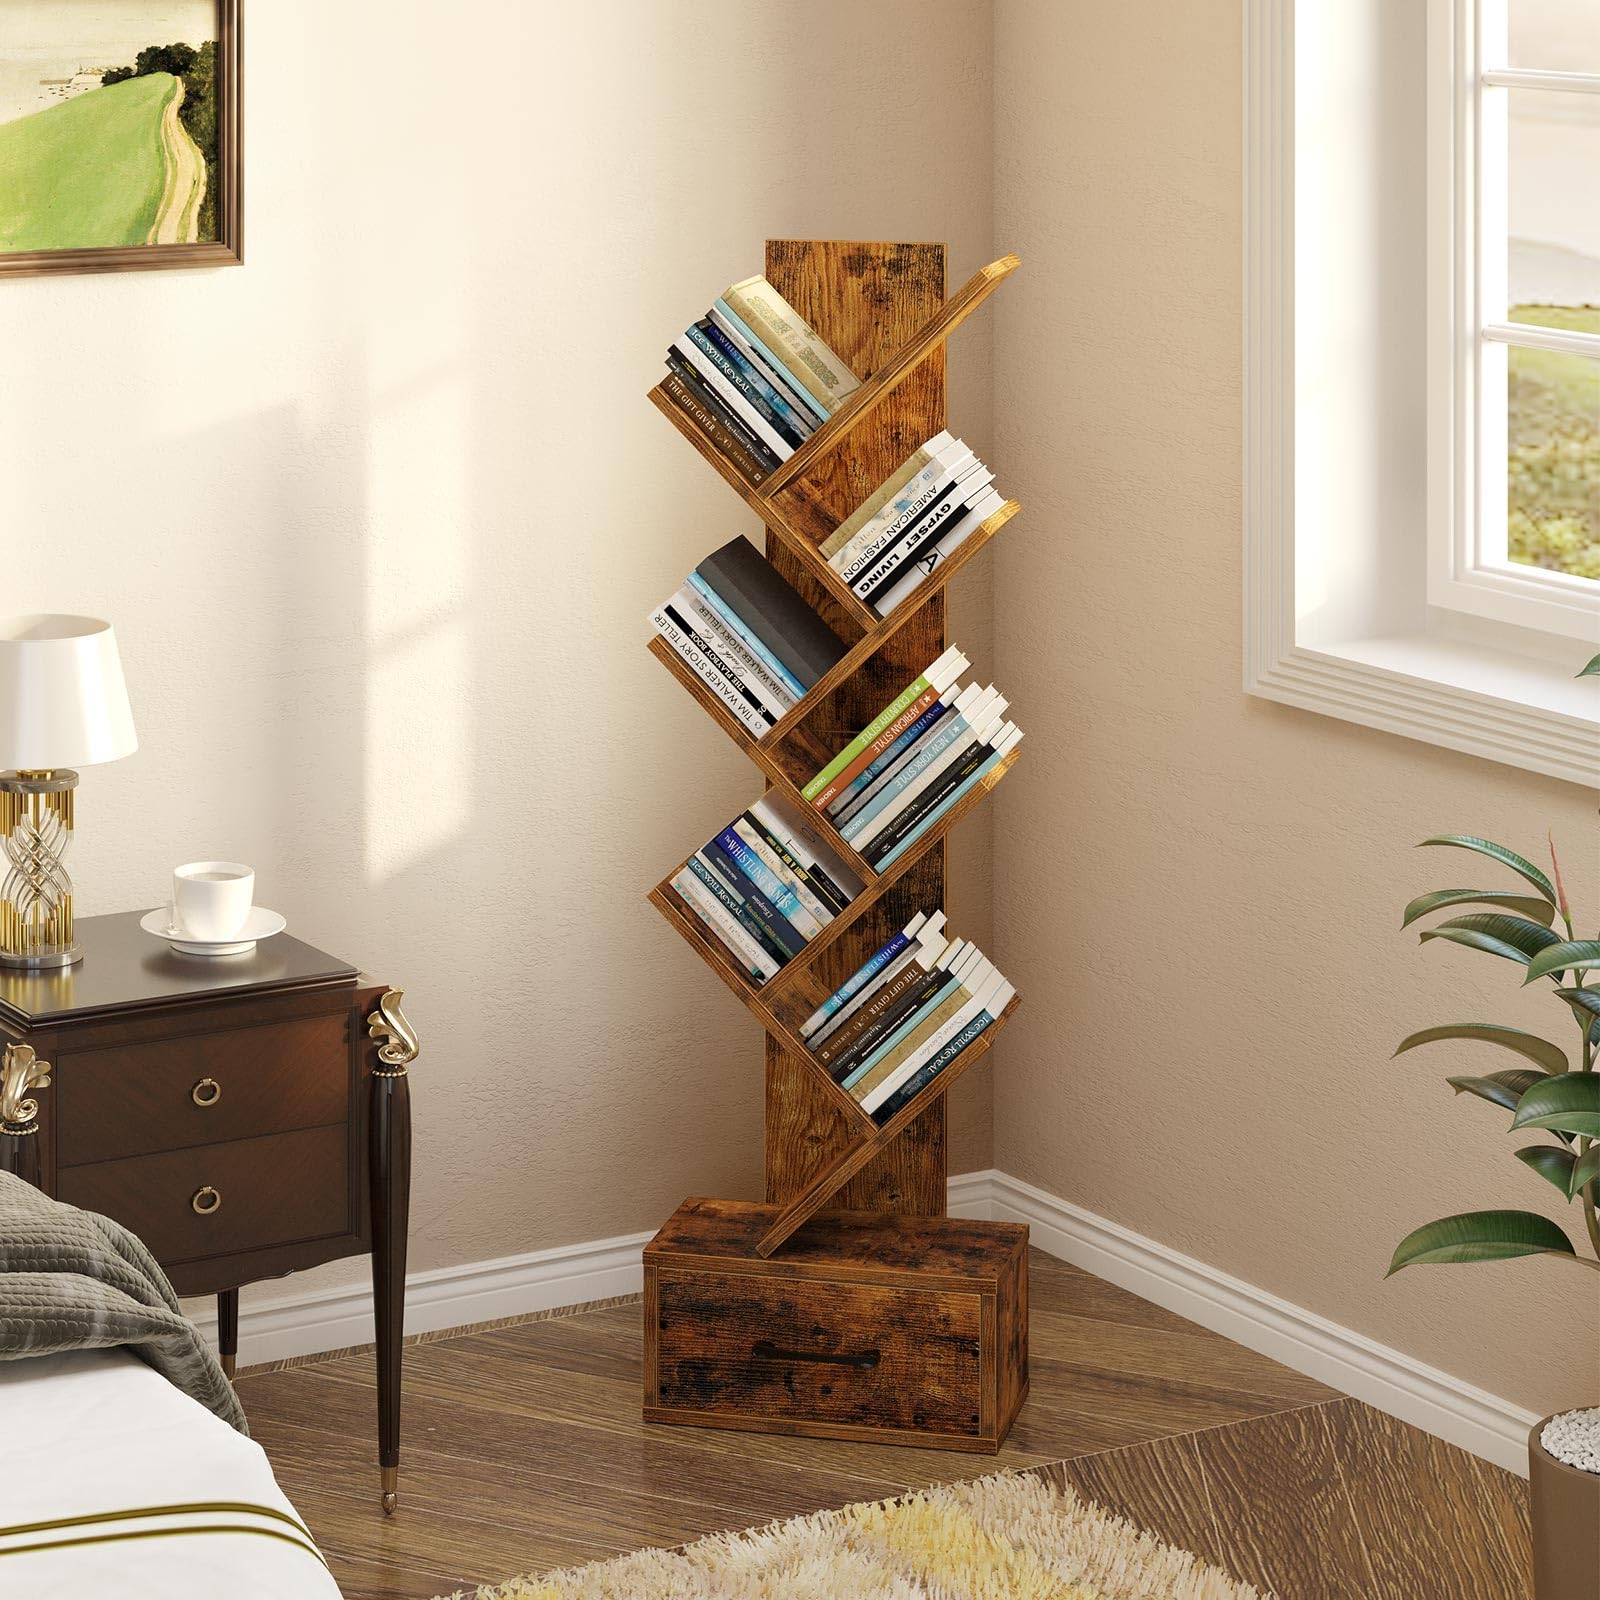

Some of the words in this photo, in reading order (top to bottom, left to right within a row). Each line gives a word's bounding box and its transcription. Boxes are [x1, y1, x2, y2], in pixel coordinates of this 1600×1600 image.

[667, 380, 683, 396] THE
[680, 393, 698, 412] GIFT
[693, 408, 716, 432] GIVER
[885, 484, 939, 537] AMERICAN
[903, 502, 952, 550] GYPSET
[842, 535, 887, 579] FASHION
[858, 552, 900, 593] LIVING
[652, 613, 683, 642] TELLER
[696, 605, 723, 631] TELLER
[687, 630, 708, 651] BOOK
[718, 628, 744, 654] STORY
[678, 641, 709, 671] STORY
[703, 649, 735, 679] PLAYBOY
[740, 652, 771, 683] WALKER
[701, 668, 741, 706] WALKER
[730, 676, 746, 692] THE
[766, 681, 782, 696] TIM
[735, 703, 754, 721] TIM
[877, 694, 910, 727] COUNTRY
[889, 704, 921, 735] AFRICAN
[858, 722, 881, 745] STYLE
[870, 730, 894, 753] STYLE
[929, 735, 949, 754] NEW
[912, 749, 934, 770] YORK
[805, 775, 826, 796] TASCHEN
[893, 766, 917, 789] STYLE
[815, 786, 836, 806] TASCHEN
[843, 816, 864, 836] TASCHEN
[725, 839, 770, 884] WHISTLING
[763, 880, 793, 909] SANDS
[854, 941, 899, 984] WHISTLING
[902, 967, 918, 983] THE
[887, 980, 905, 997] GIFT
[868, 993, 891, 1015] GIVER
